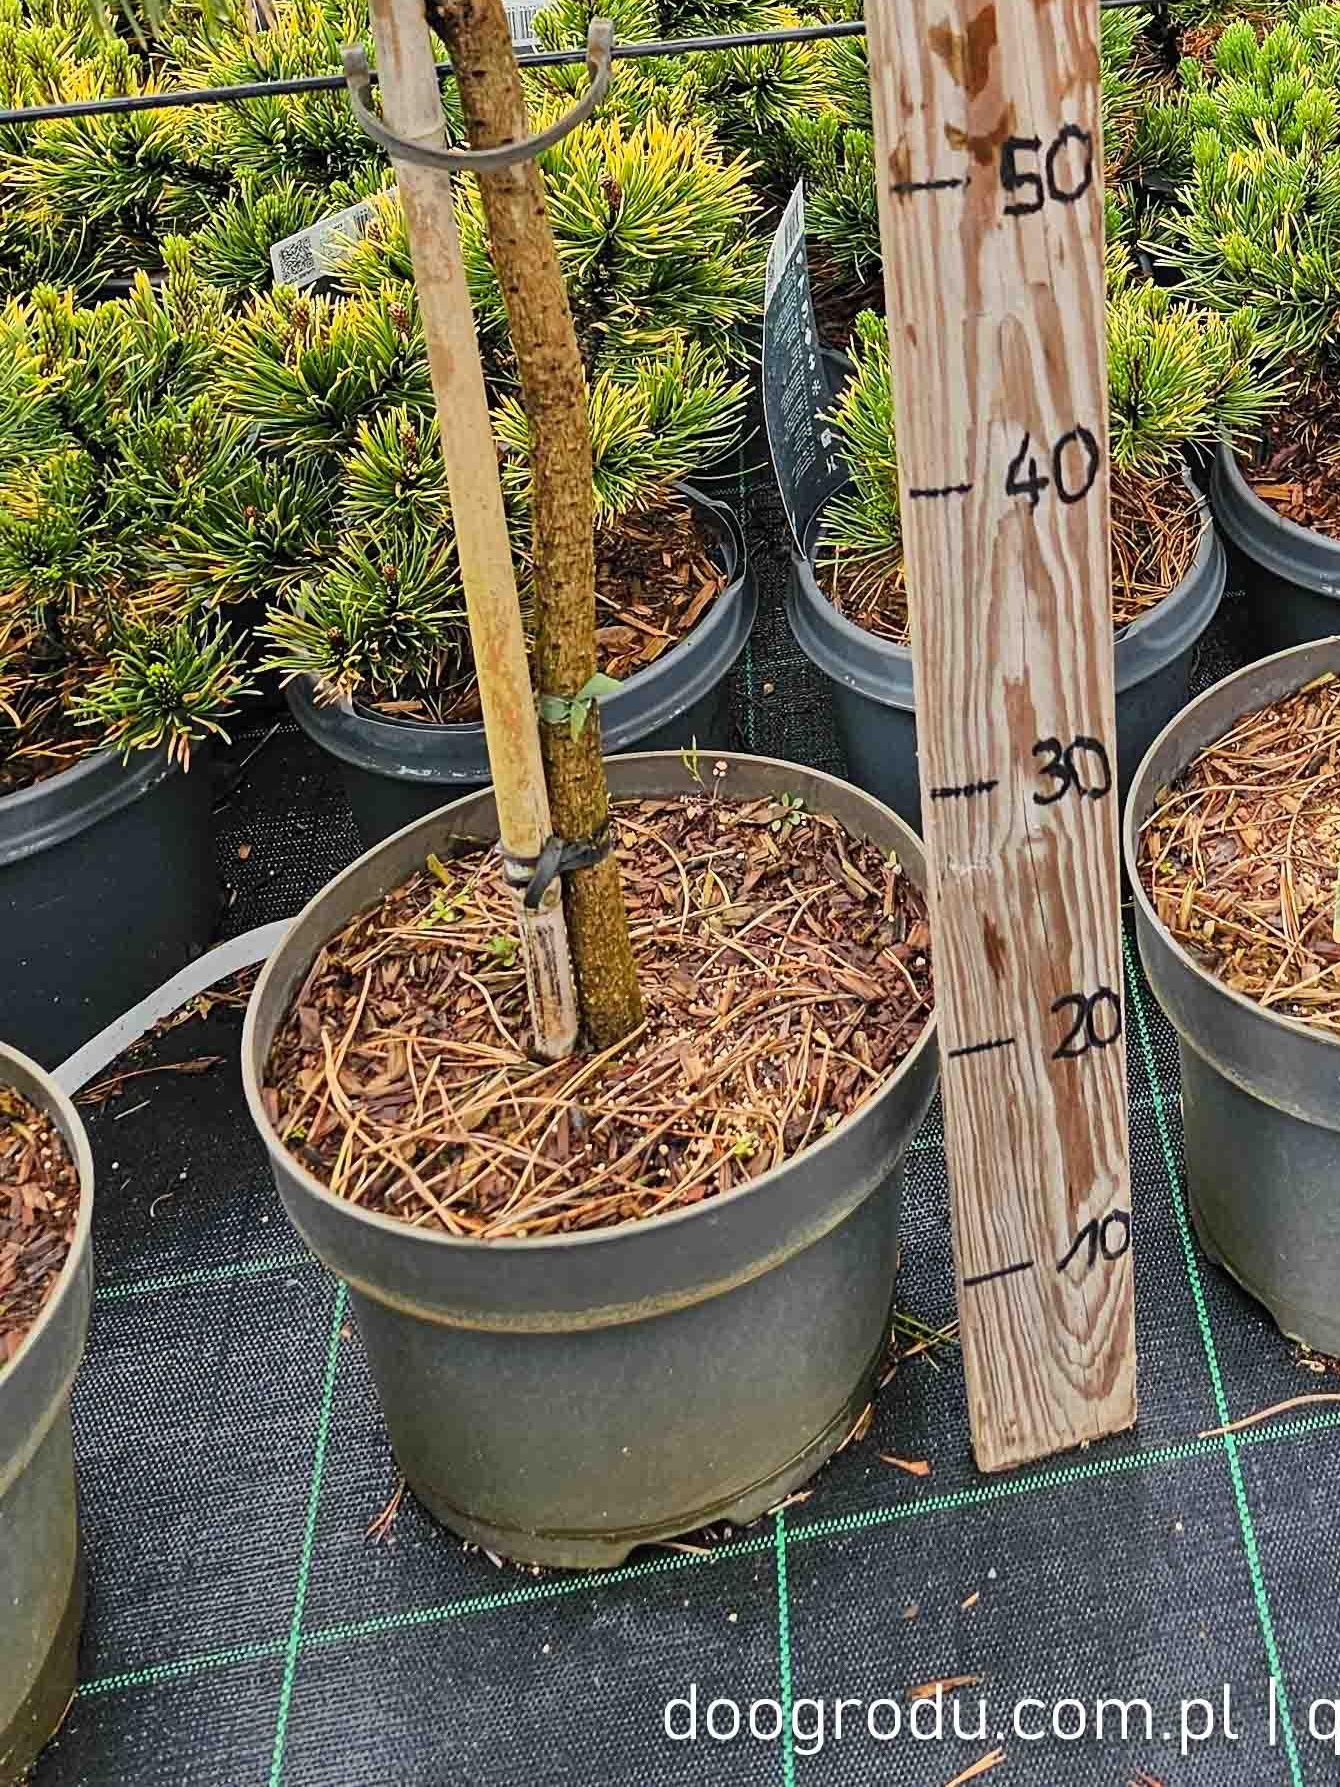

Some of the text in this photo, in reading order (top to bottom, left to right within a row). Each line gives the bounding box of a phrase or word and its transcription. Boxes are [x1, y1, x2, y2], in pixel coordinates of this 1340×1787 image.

[1000, 122, 1093, 218] 50
[1006, 423, 1100, 510] 40
[1031, 735, 1112, 806] 30
[1051, 985, 1123, 1061] 20
[1056, 1209, 1131, 1274] 10
